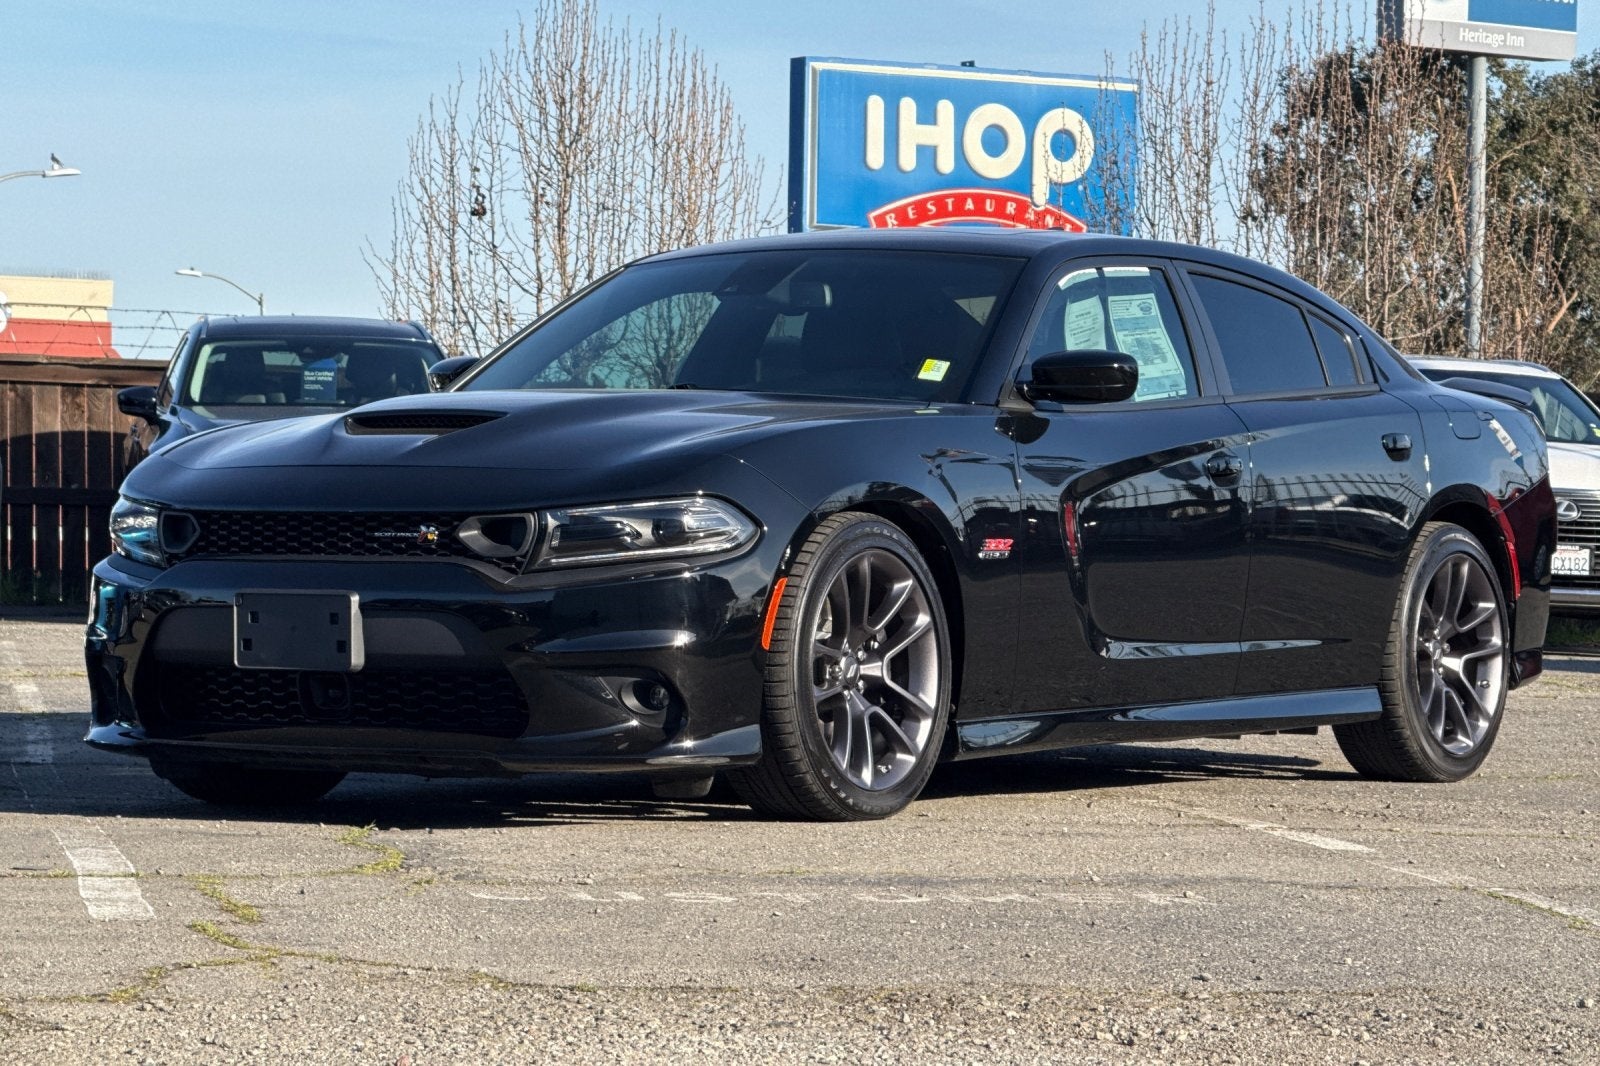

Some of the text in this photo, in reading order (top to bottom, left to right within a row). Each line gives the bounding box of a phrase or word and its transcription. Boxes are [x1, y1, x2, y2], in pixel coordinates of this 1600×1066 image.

[1460, 28, 1525, 48] Heritage Inn
[983, 538, 1014, 550] 392
[1553, 556, 1588, 571] CX182
